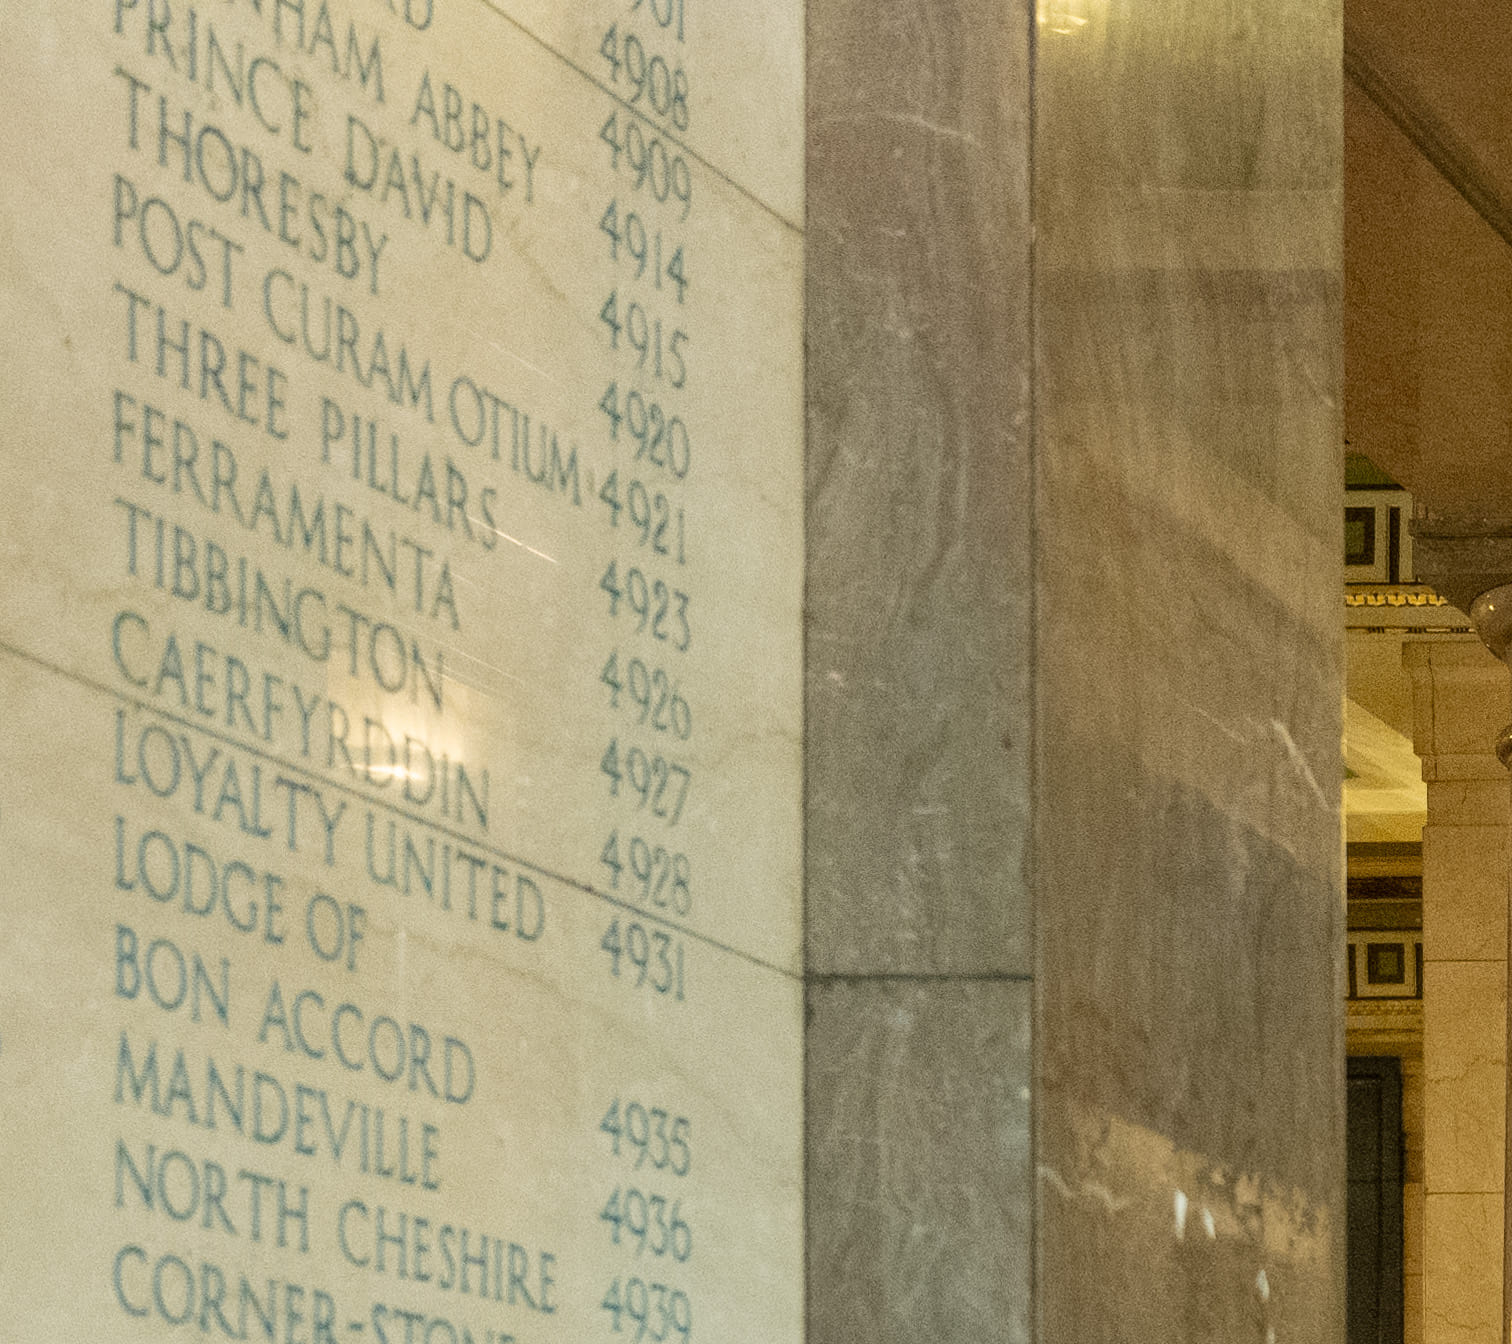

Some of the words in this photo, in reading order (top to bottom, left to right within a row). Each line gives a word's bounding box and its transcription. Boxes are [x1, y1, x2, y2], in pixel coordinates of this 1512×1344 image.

[410, 70, 540, 204] ABBEY
[600, 200, 690, 304] 4914
[600, 22, 690, 132] 4908
[600, 109, 692, 222] 4909
[115, 67, 388, 295] THORESBY
[599, 380, 689, 480] 4920
[115, 176, 243, 318] POST
[262, 267, 432, 425] CURAM
[449, 375, 582, 508] OTIUM
[599, 470, 686, 566] 4921
[343, 113, 494, 264] DAVID
[601, 292, 688, 390] 4915
[115, 283, 288, 442] THREE
[320, 395, 499, 552] PILLARS
[599, 558, 690, 653] 4923
[115, 394, 461, 629] FERRAMENTA
[113, 612, 490, 831] CAERFYRDDIN
[601, 830, 691, 917] 4928
[115, 498, 444, 710] TIBBINGTON
[601, 740, 690, 826] 4927
[115, 711, 348, 869] LOYALTY
[367, 816, 547, 943] UNITED
[601, 918, 686, 1002] 4931
[115, 816, 285, 946] LODGE
[307, 891, 369, 973] OF
[115, 924, 231, 1027] BON
[260, 980, 478, 1104] ACCORD
[601, 1099, 691, 1177] 4935
[115, 1034, 442, 1191] MANDEVILLE
[601, 1185, 693, 1263] 4936
[115, 1142, 309, 1252] NORTH
[338, 1198, 558, 1313] CHESHIRE
